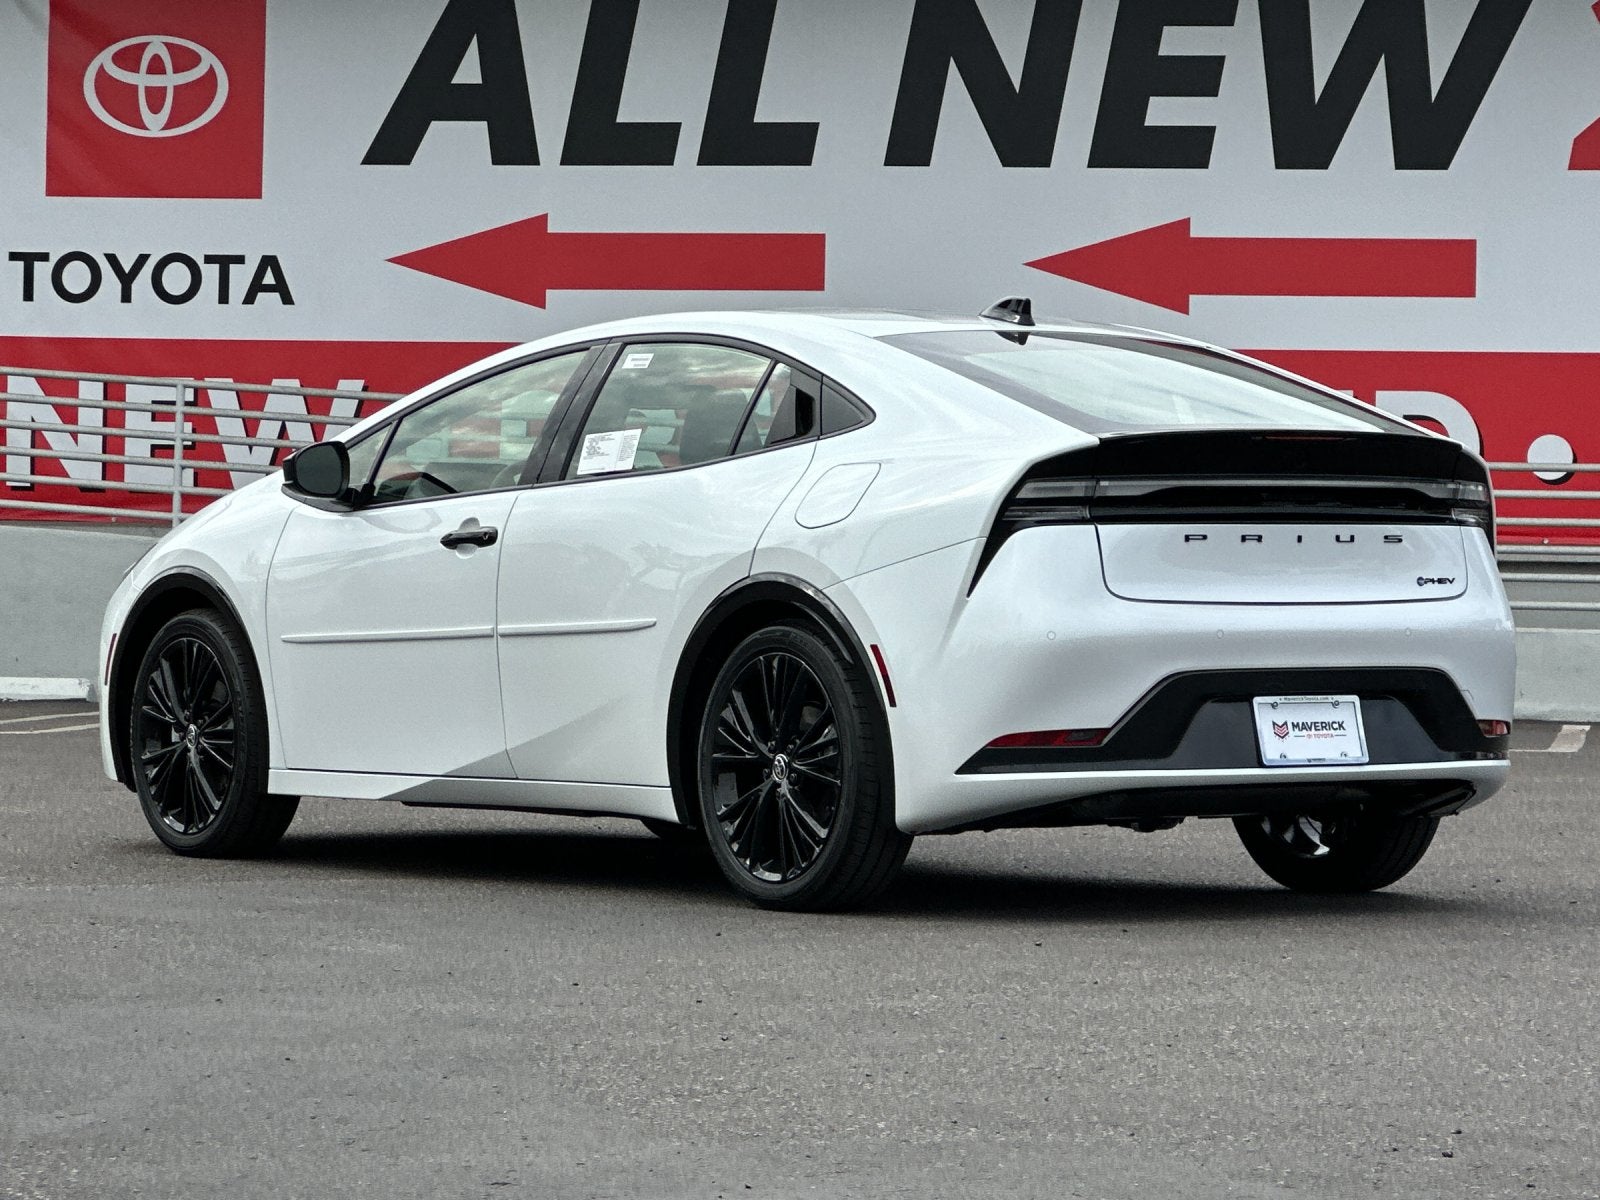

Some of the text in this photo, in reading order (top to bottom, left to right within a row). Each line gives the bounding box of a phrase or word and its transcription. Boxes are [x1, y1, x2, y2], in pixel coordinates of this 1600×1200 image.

[359, 0, 821, 167] ALL
[883, 0, 1533, 171] NEW
[8, 250, 296, 305] TOYOTA
[5, 374, 366, 490] NEW
[1184, 534, 1404, 544] PRIUS
[1424, 577, 1456, 585] PHEV
[1291, 720, 1346, 732] MAVERICK
